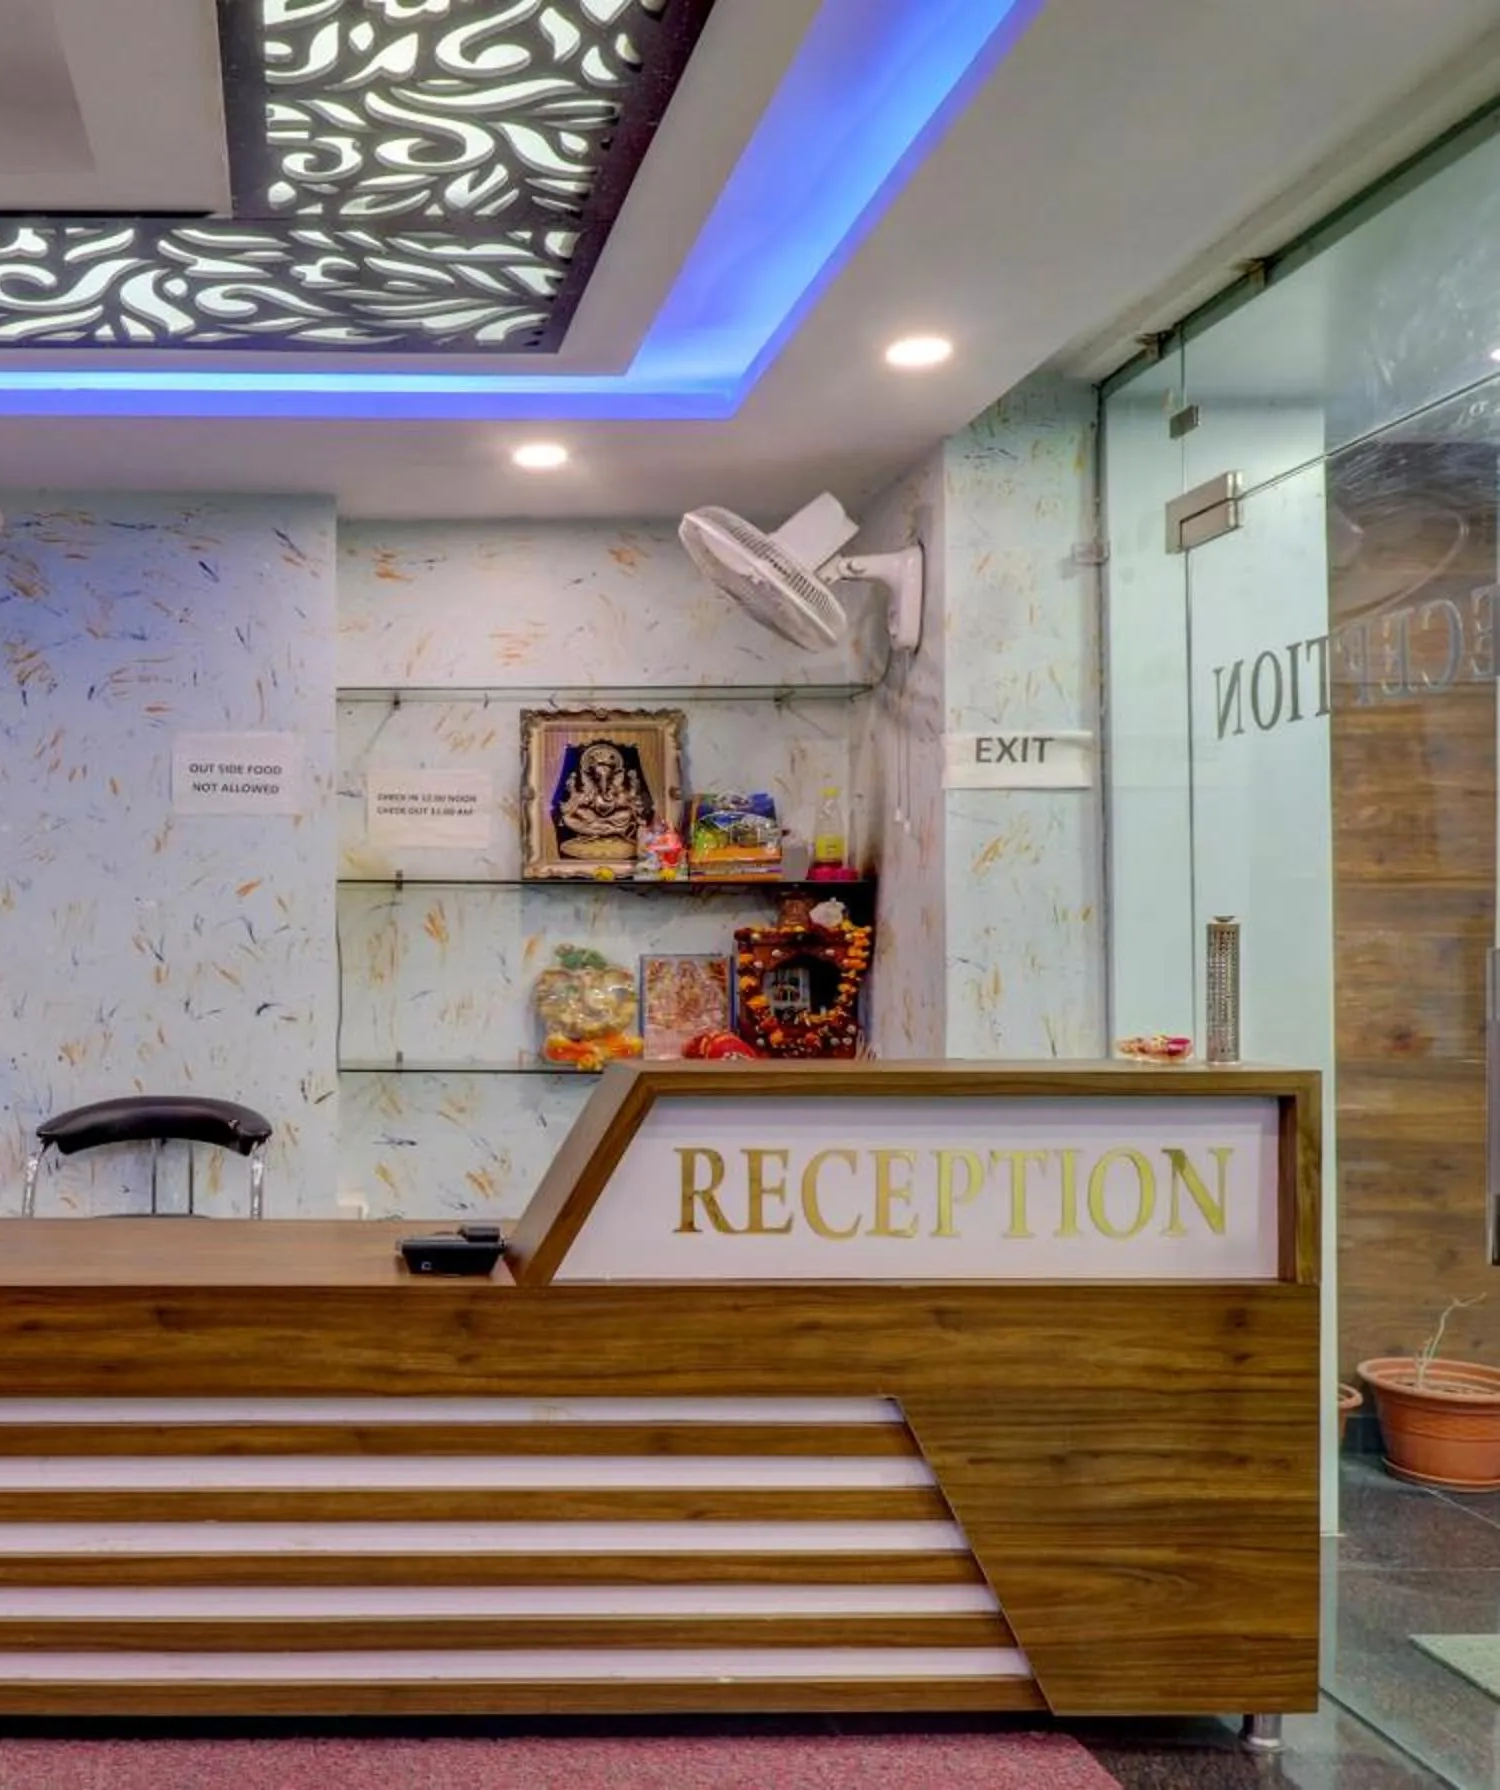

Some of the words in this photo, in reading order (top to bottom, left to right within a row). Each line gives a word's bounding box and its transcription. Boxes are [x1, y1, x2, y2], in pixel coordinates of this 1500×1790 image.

[976, 736, 1055, 763] EXIT
[189, 763, 214, 773] OUT
[218, 764, 243, 774] SIDE
[247, 765, 282, 775] FOOD
[192, 782, 217, 792] NOT
[221, 783, 280, 794] ALLOWED
[377, 807, 406, 815] CHECK
[408, 807, 428, 815] OUT
[673, 1147, 1234, 1240] RECEPTION
